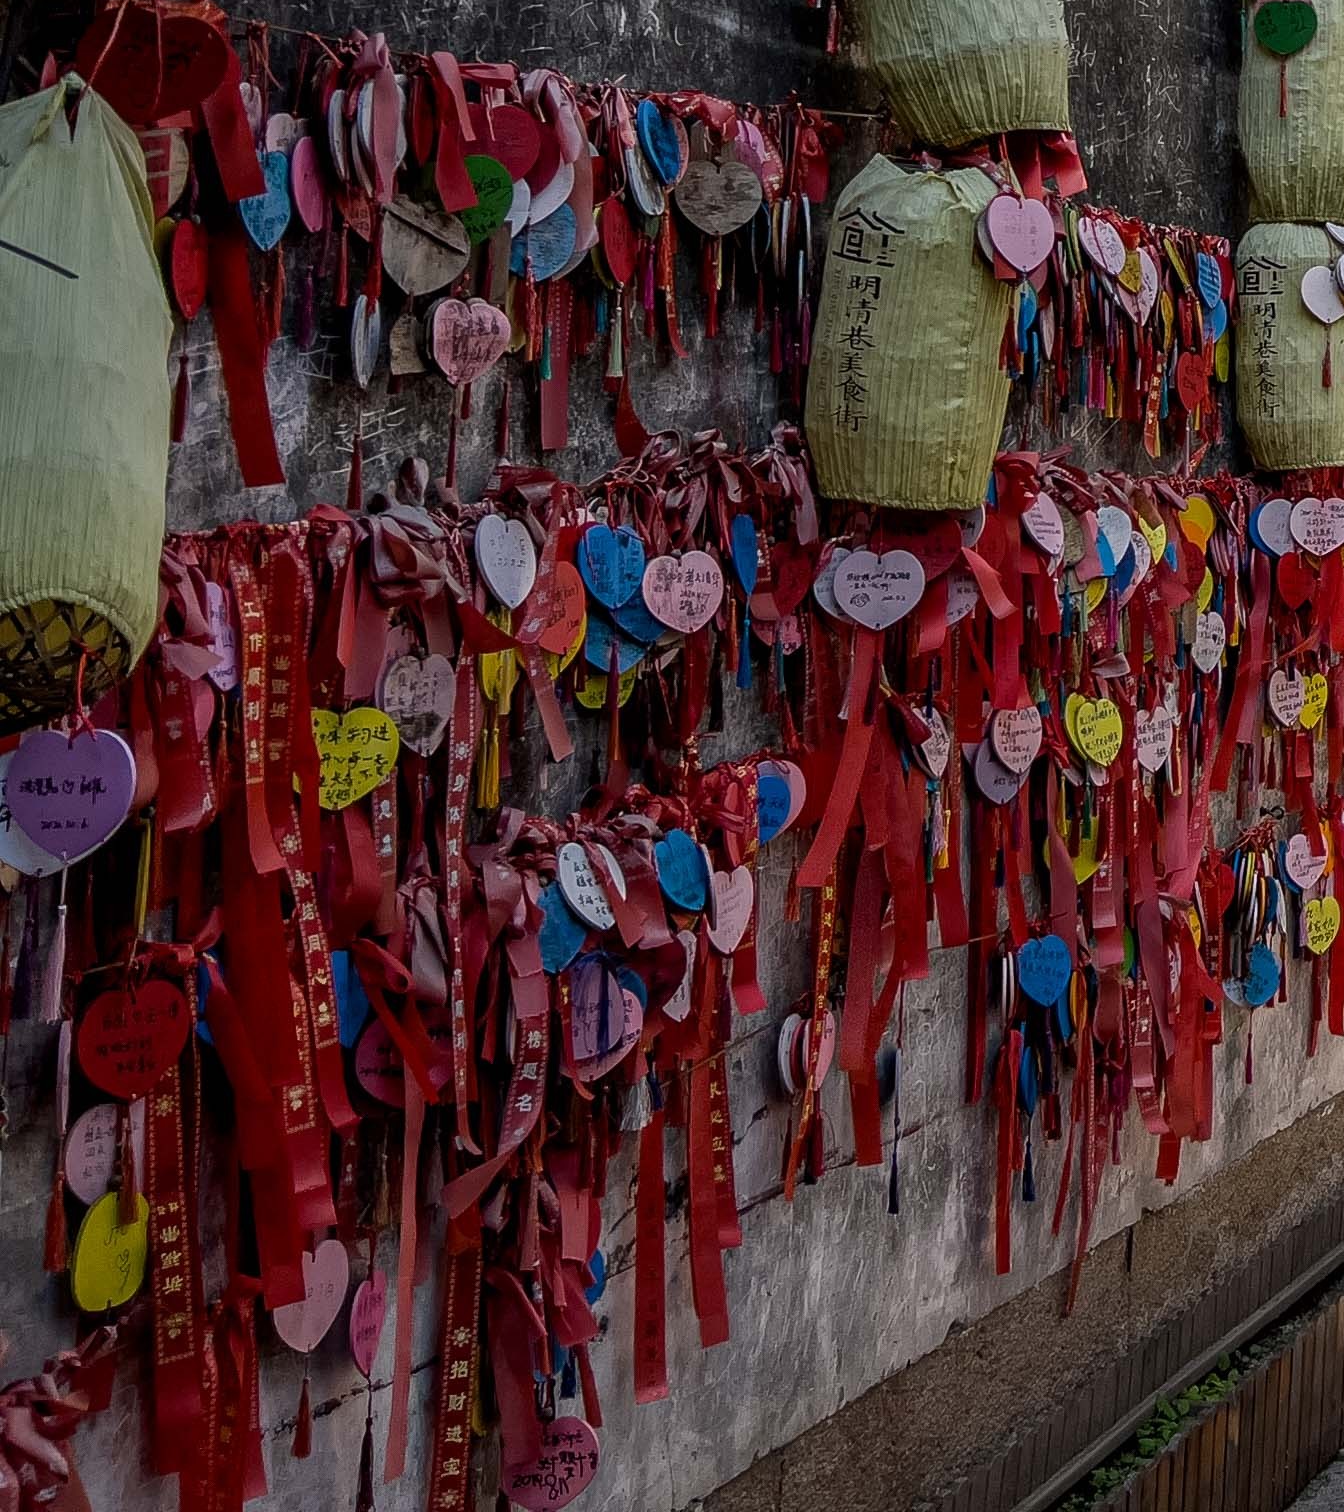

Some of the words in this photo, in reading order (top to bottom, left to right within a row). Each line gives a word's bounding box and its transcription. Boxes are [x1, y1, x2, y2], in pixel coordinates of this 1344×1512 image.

[831, 274, 882, 432] 明清巷美食街
[1252, 302, 1281, 418] 明清巷美食街
[243, 601, 263, 721] 工作顺利
[294, 869, 329, 986] 永结同心
[440, 1359, 469, 1479] 招财进宝
